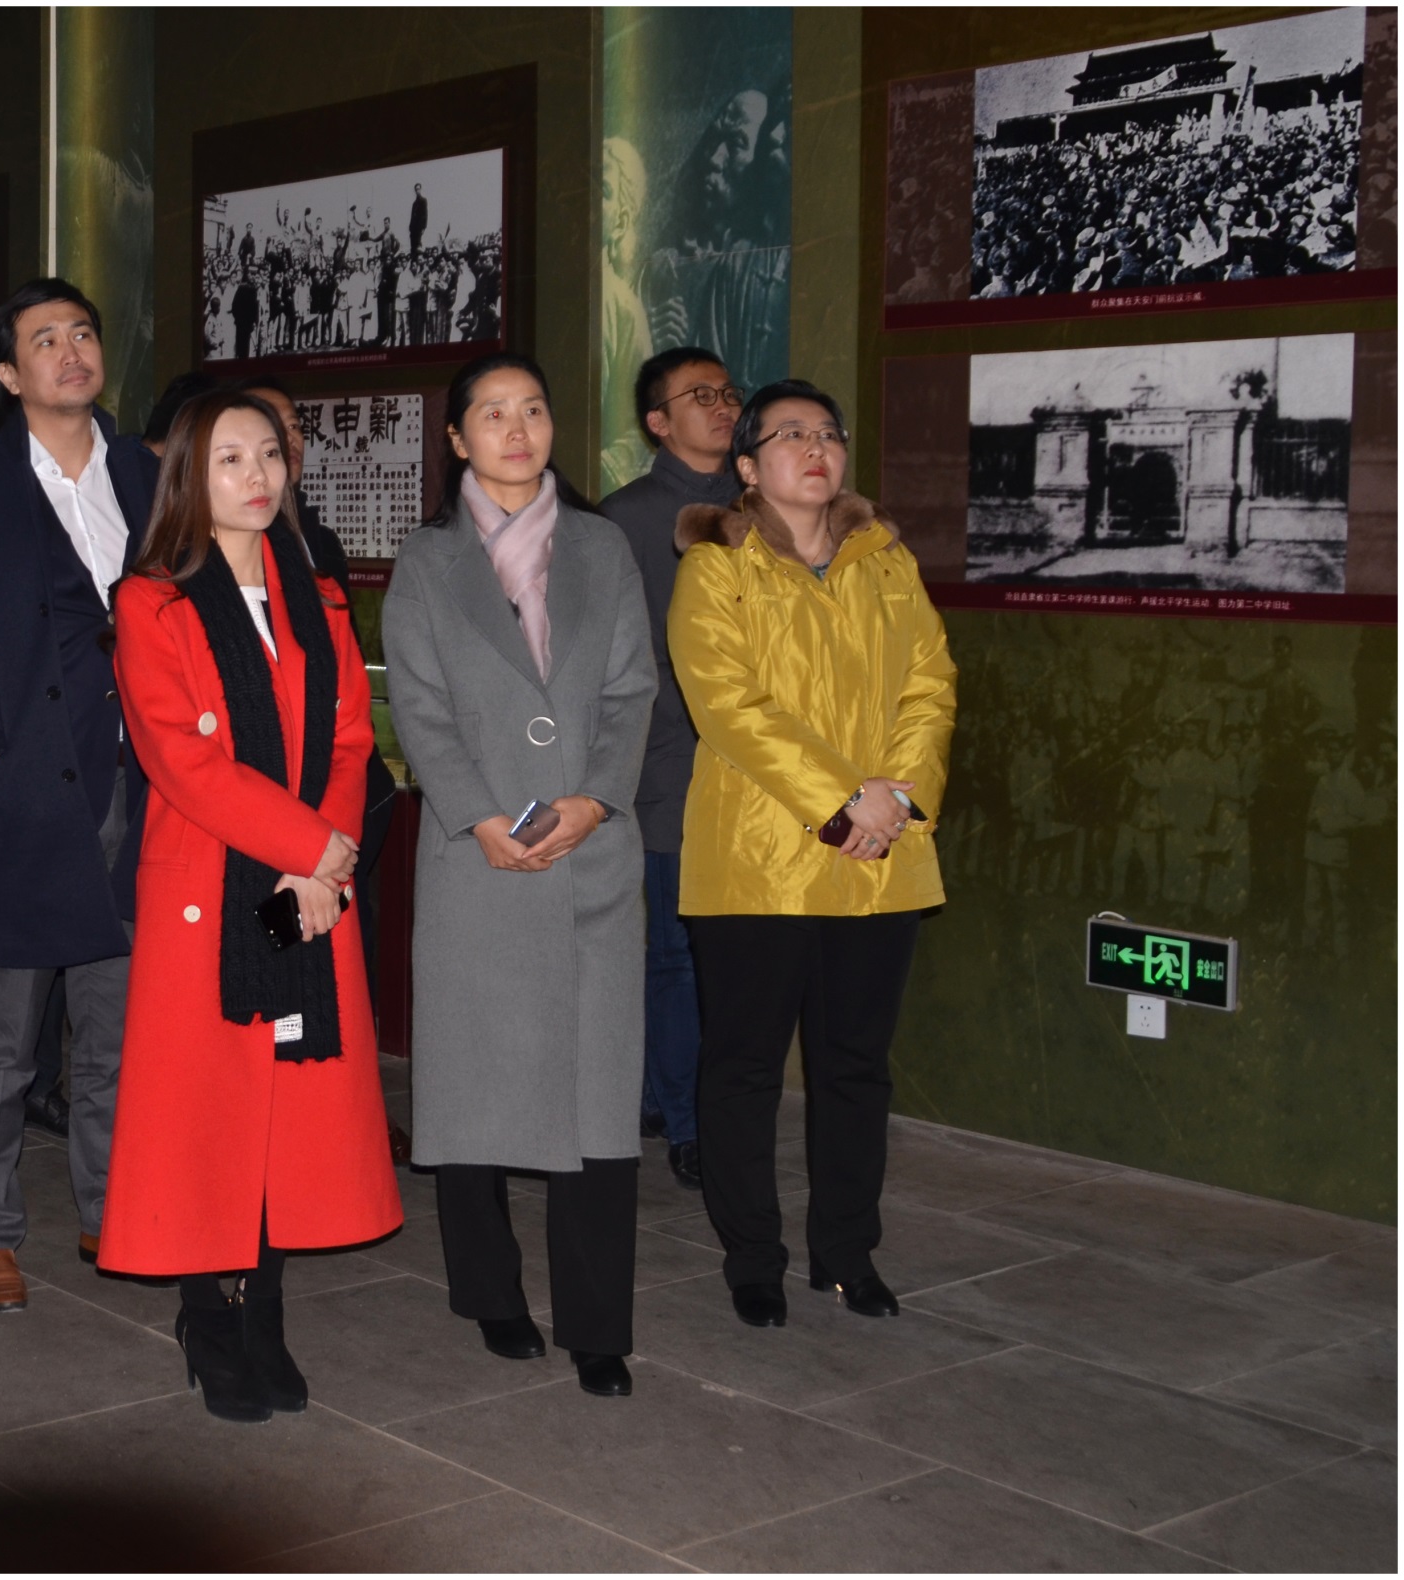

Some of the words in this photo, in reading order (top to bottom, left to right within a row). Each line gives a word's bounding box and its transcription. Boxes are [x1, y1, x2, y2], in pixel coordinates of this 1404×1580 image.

[1101, 942, 1118, 962] EXIT
[1197, 958, 1224, 981] 安全出口
